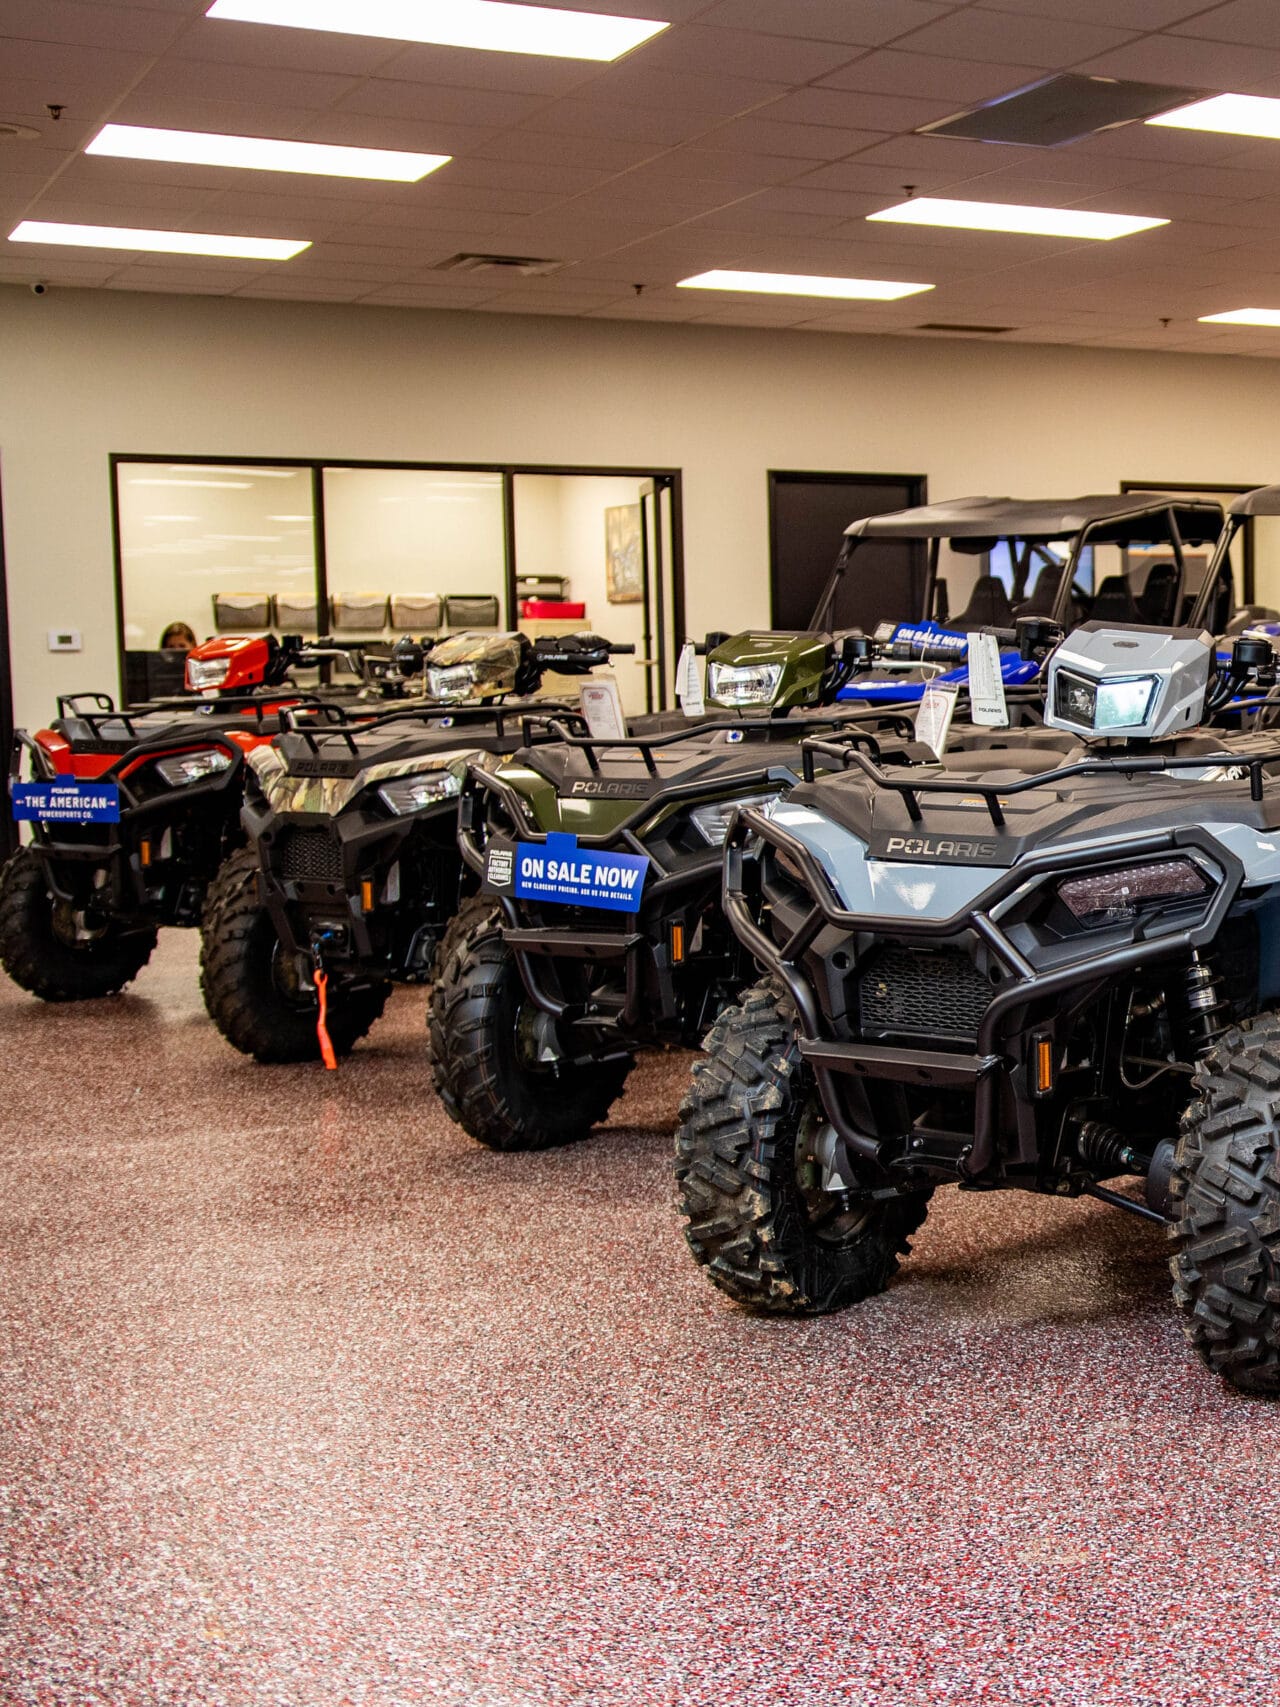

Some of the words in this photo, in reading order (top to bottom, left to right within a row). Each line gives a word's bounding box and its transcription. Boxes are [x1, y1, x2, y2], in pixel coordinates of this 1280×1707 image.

[941, 636, 967, 649] NOW
[571, 781, 650, 794] POLARIS
[24, 795, 46, 808] THE
[49, 796, 107, 809] AMERICAN
[886, 837, 998, 858] POLARIS
[521, 857, 545, 879] ON
[547, 862, 592, 885] SALE
[594, 866, 640, 890] NOW
